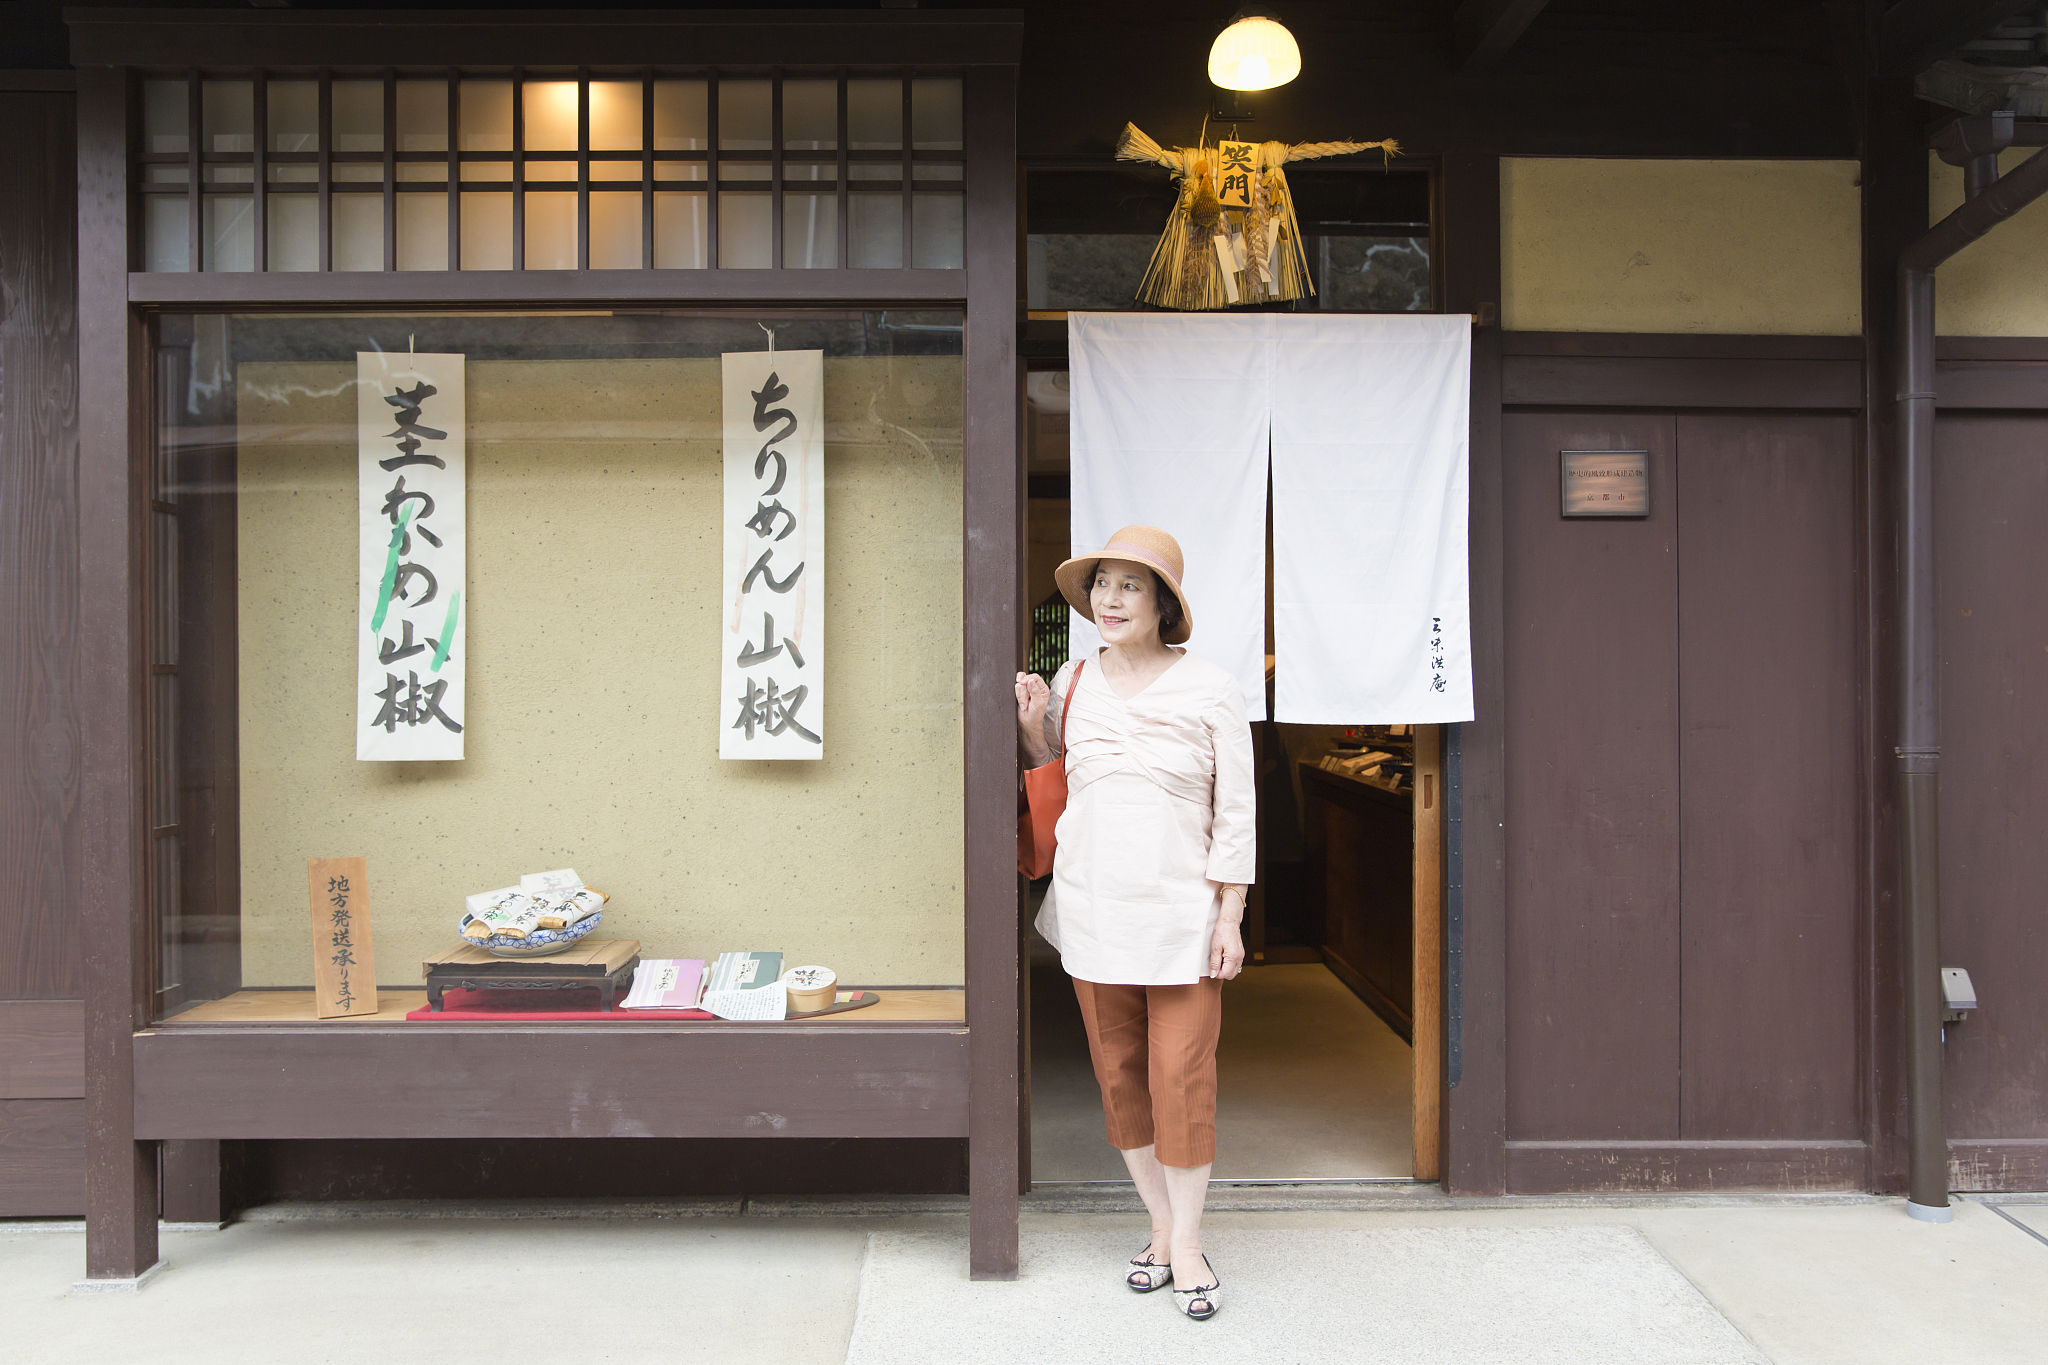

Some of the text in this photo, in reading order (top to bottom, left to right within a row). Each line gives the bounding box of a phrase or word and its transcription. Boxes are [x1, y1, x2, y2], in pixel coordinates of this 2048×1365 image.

[1219, 144, 1255, 205] 笑門
[1586, 493, 1626, 502] 京都市
[370, 380, 464, 734] 茎わかめ山椒
[731, 371, 822, 745] ちりめん山椒
[1429, 617, 1447, 693] 三味洪庵
[327, 874, 357, 1012] 地方発送承ります
